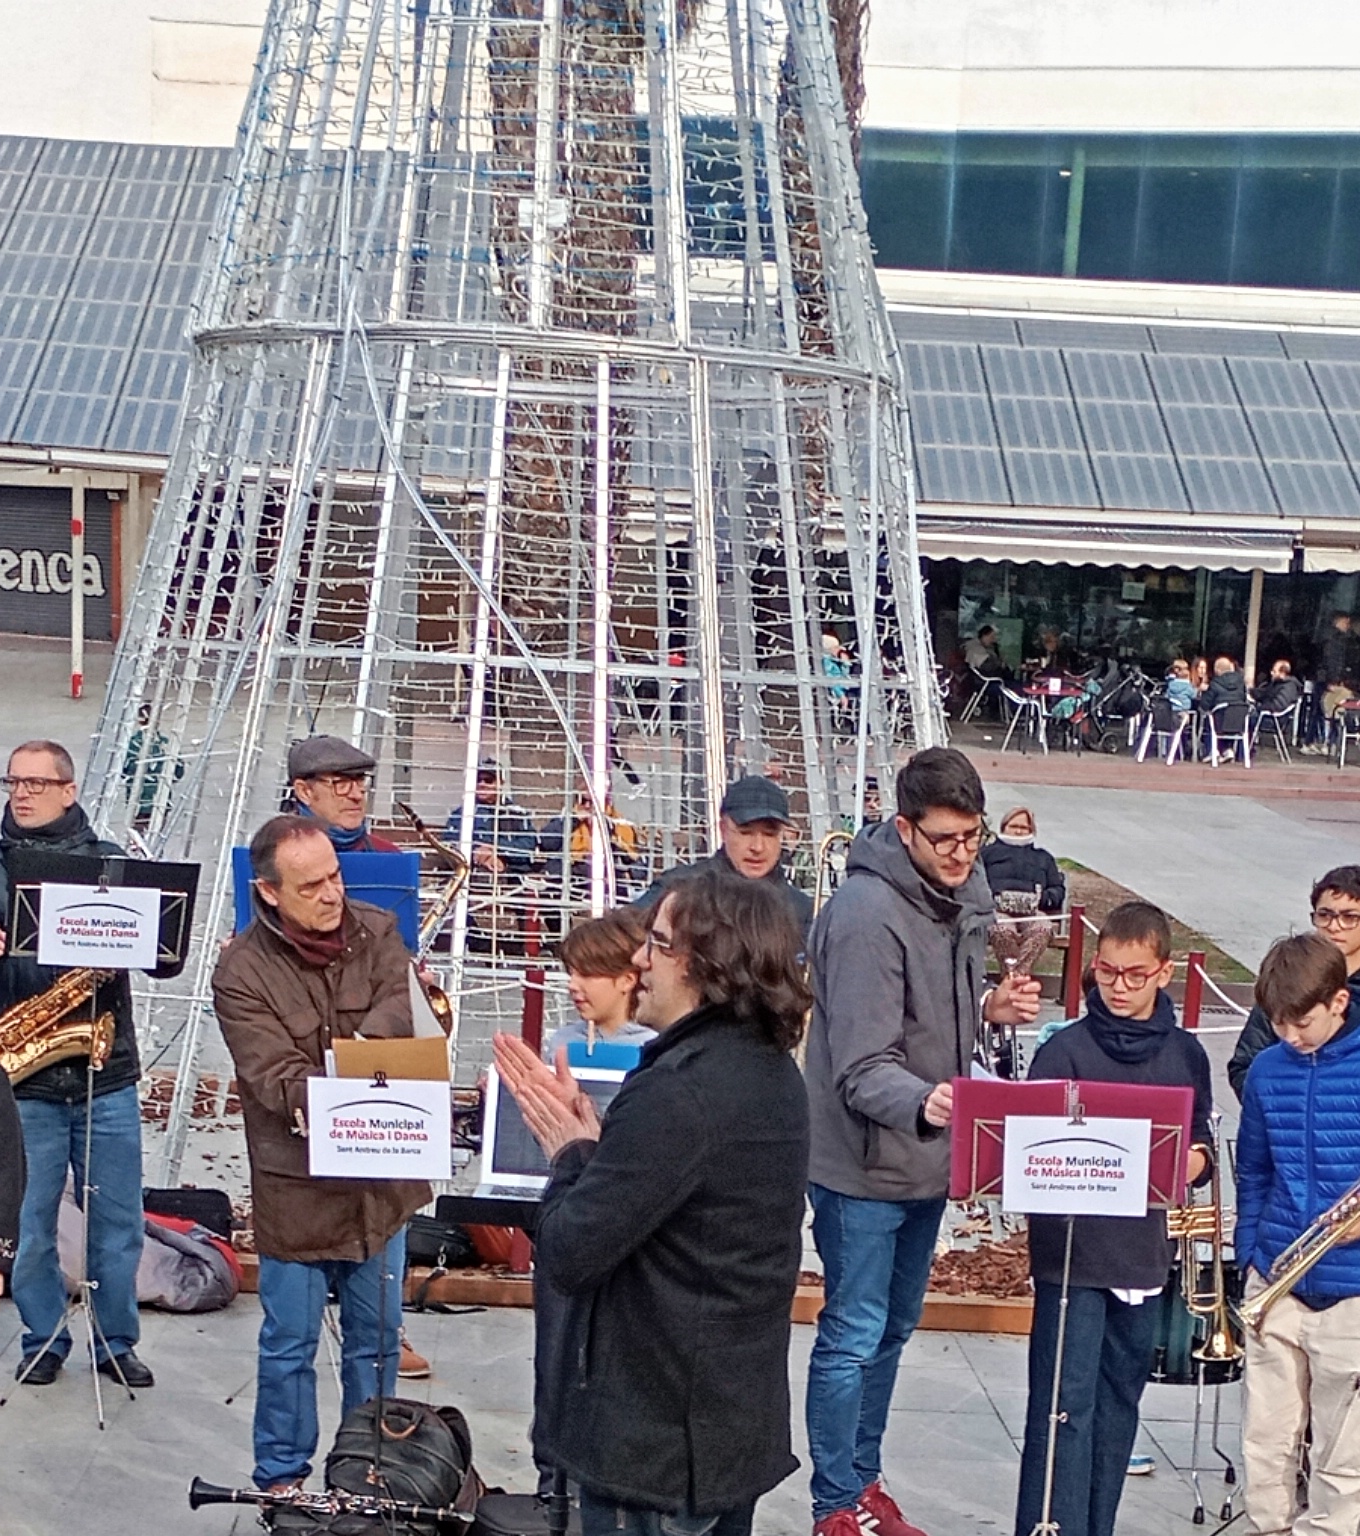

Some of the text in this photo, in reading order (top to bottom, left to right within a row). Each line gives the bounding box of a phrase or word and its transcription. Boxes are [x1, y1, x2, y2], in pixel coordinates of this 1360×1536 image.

[60, 917, 137, 929] Escola Municipal
[56, 926, 69, 935] de
[71, 927, 104, 937] Música
[111, 929, 140, 938] Dansa
[332, 1117, 425, 1131] Escola Municipal
[329, 1128, 344, 1139] de
[346, 1128, 385, 1140] Música
[393, 1130, 429, 1142] Dansa
[1028, 1155, 1122, 1169] Escola Municipal
[1024, 1166, 1039, 1177] de
[1041, 1166, 1081, 1178] Música
[1090, 1168, 1126, 1180] Dansa
